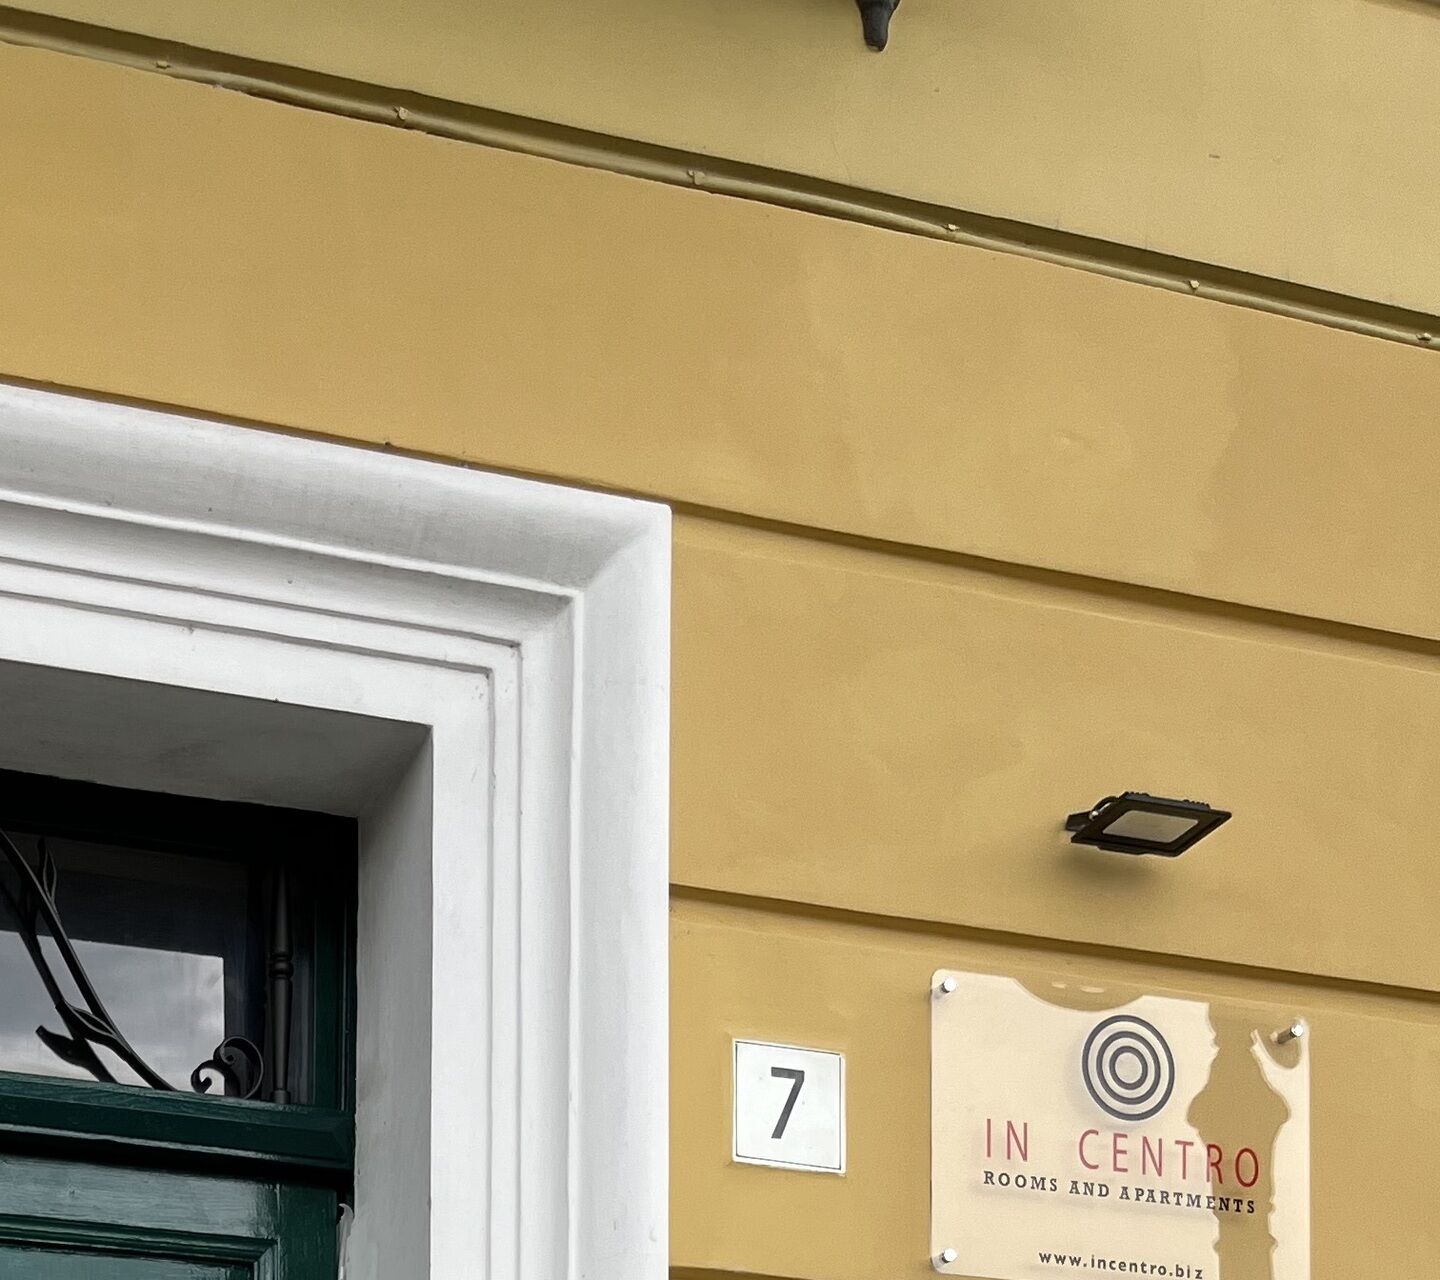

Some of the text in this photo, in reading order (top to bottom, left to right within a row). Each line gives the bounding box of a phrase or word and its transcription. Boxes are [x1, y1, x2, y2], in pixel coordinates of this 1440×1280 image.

[769, 1066, 806, 1140] 7
[985, 1117, 1261, 1189] IN CENTRO
[983, 1170, 1257, 1214] ROOMS AND APARTMENTS
[1038, 1250, 1205, 1280] www.incentro.biz
